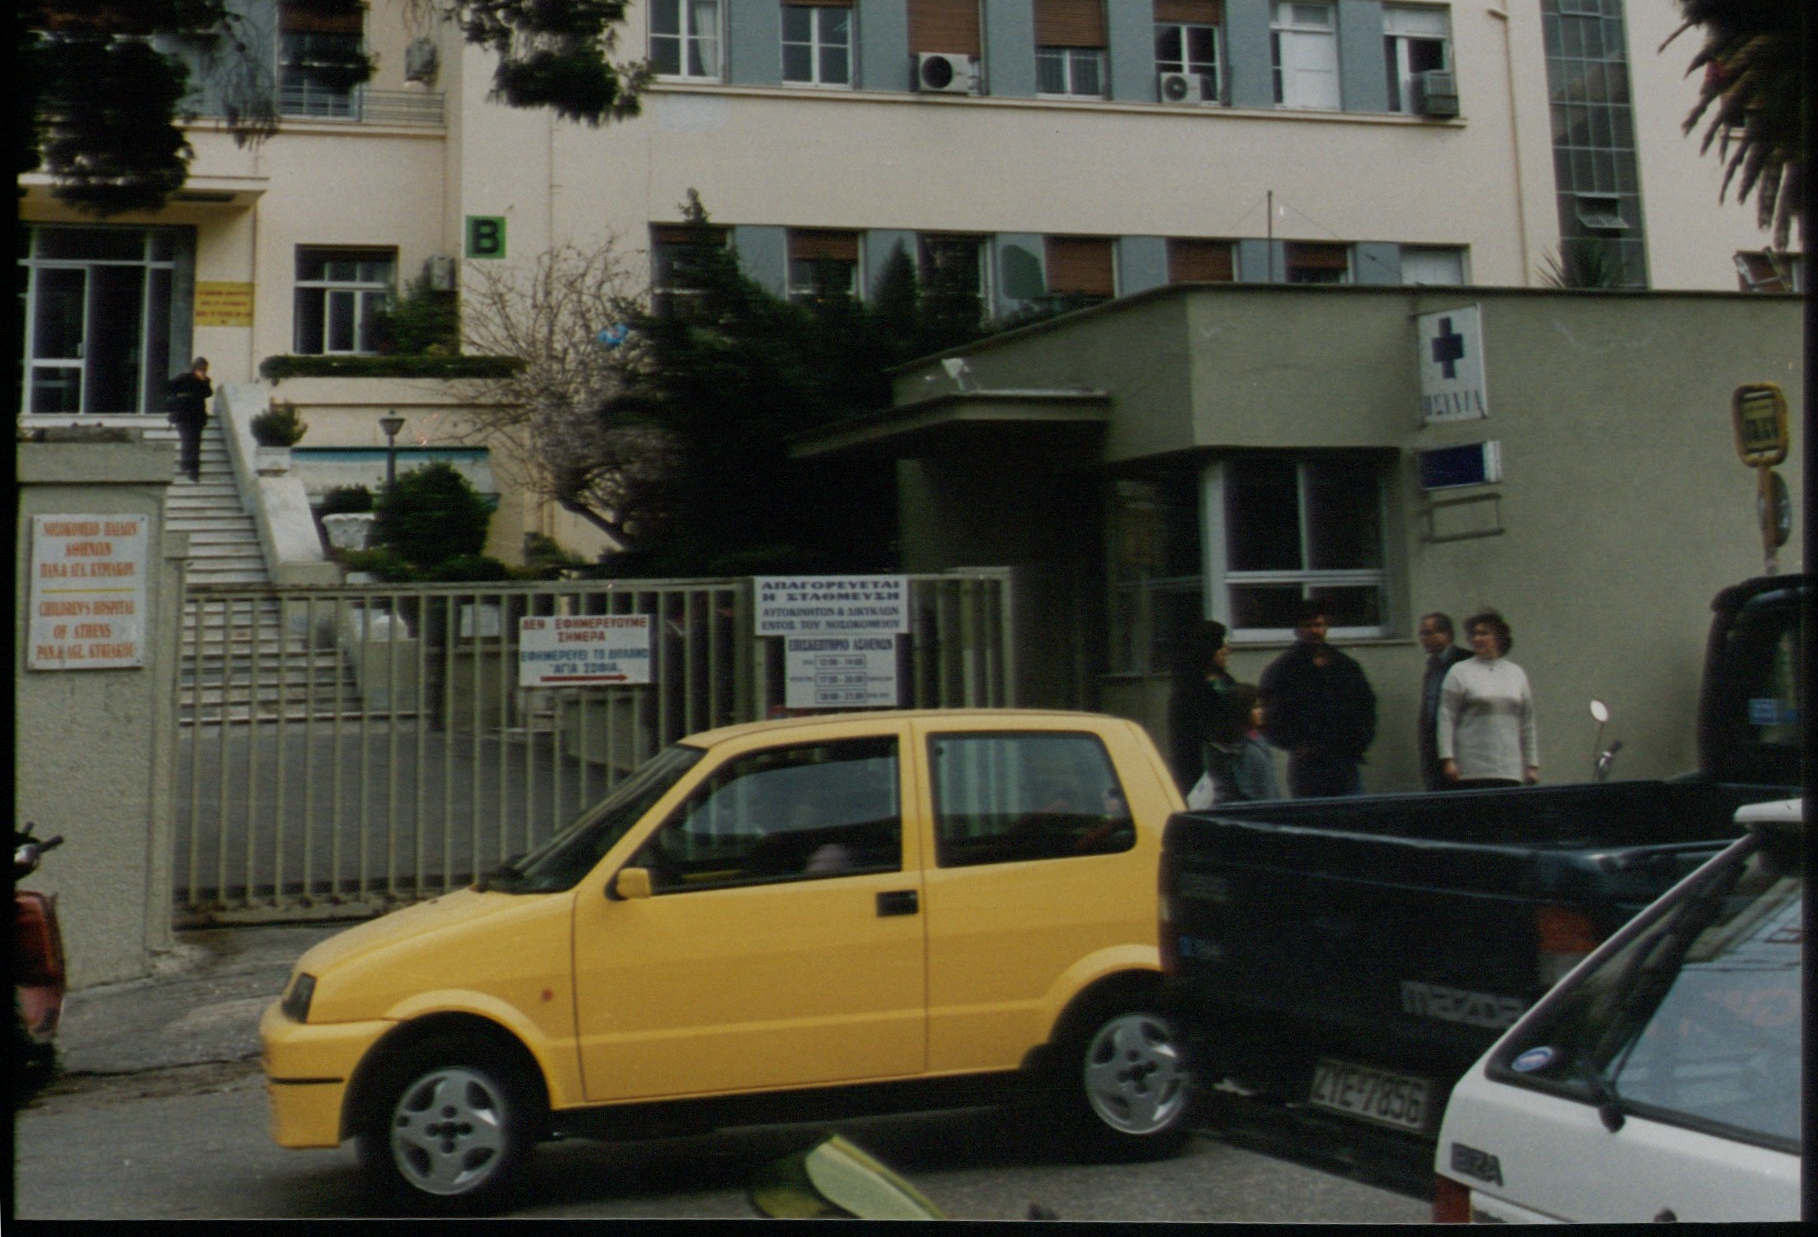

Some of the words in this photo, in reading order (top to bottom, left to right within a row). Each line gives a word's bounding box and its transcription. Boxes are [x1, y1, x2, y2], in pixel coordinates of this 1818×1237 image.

[761, 581, 899, 590] ΑΠΑΓΟΡΕΥΕΤΑΙ
[762, 593, 776, 601] Η
[785, 592, 900, 601] ΣΤΑΘΜΕΥΣΗ
[93, 600, 135, 614] HOSPITAL
[522, 619, 545, 630] ΔΕΝ
[555, 617, 648, 629] ΕΦΗΜΕΡΕΥΟΥΜΕ
[761, 620, 796, 630] ΕΝΤΟΣ
[800, 620, 821, 630] ΤΟΥ
[825, 619, 900, 630] ΝΟΣΟΚΟΜΕΙΟΥ
[53, 625, 67, 639] OF
[74, 623, 111, 638] ATHENS
[558, 630, 606, 642] ΣΗΜΕΡΑ
[521, 649, 588, 662] ΕΦΗΜΕΡΕΥΕΙ
[593, 649, 605, 660] ΤΟ
